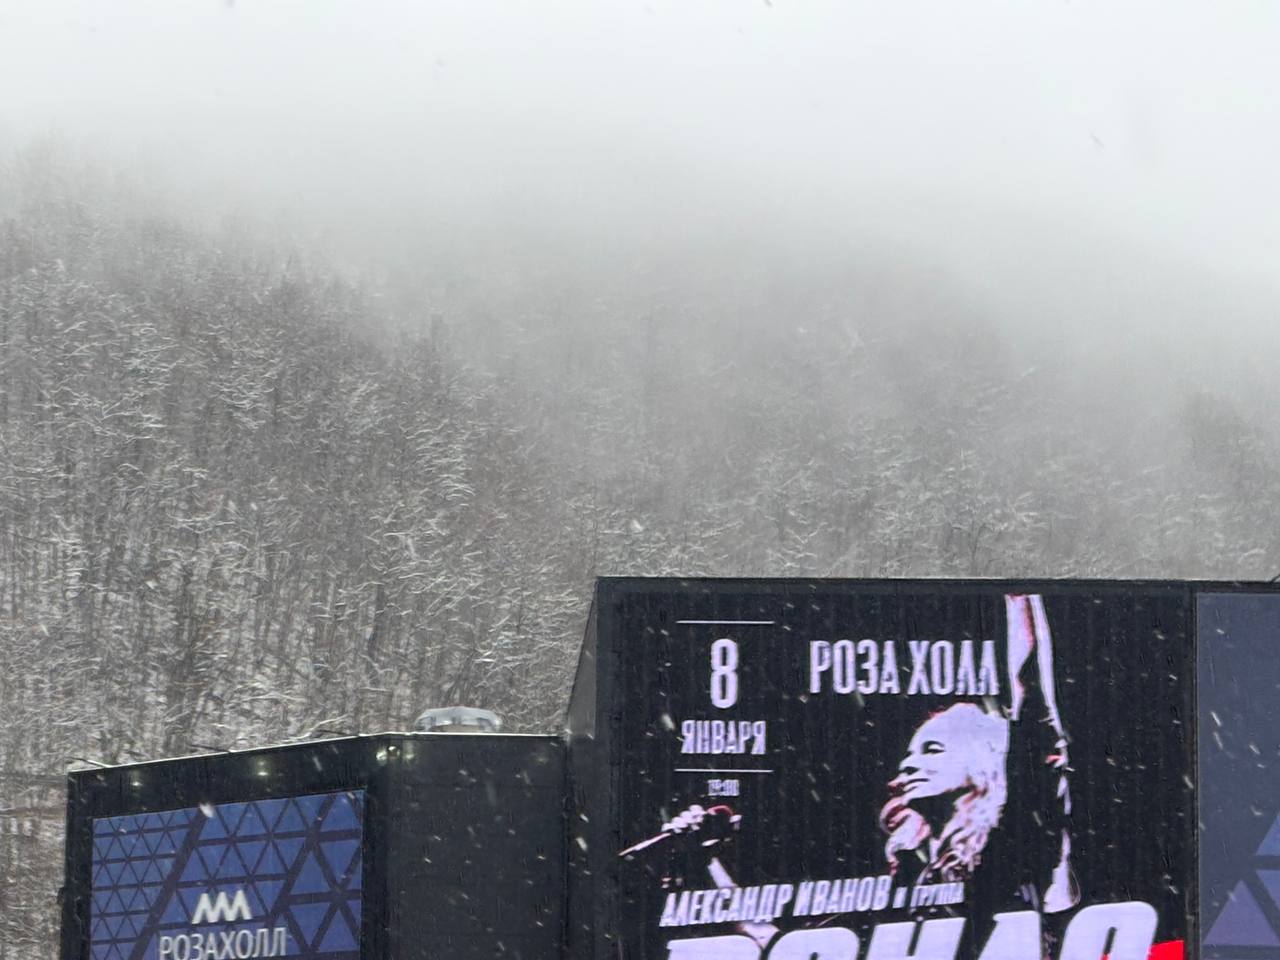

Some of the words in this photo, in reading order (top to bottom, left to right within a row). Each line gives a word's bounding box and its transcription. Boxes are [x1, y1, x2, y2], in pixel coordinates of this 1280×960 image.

[710, 638, 739, 709] 8
[809, 639, 901, 695] РОЗА
[906, 639, 1000, 696] ХОЛЛ
[680, 720, 767, 755] ЯНВАРЯ
[659, 883, 794, 927] АЛЕКСАНДР
[792, 875, 892, 917] ИВАНОВ
